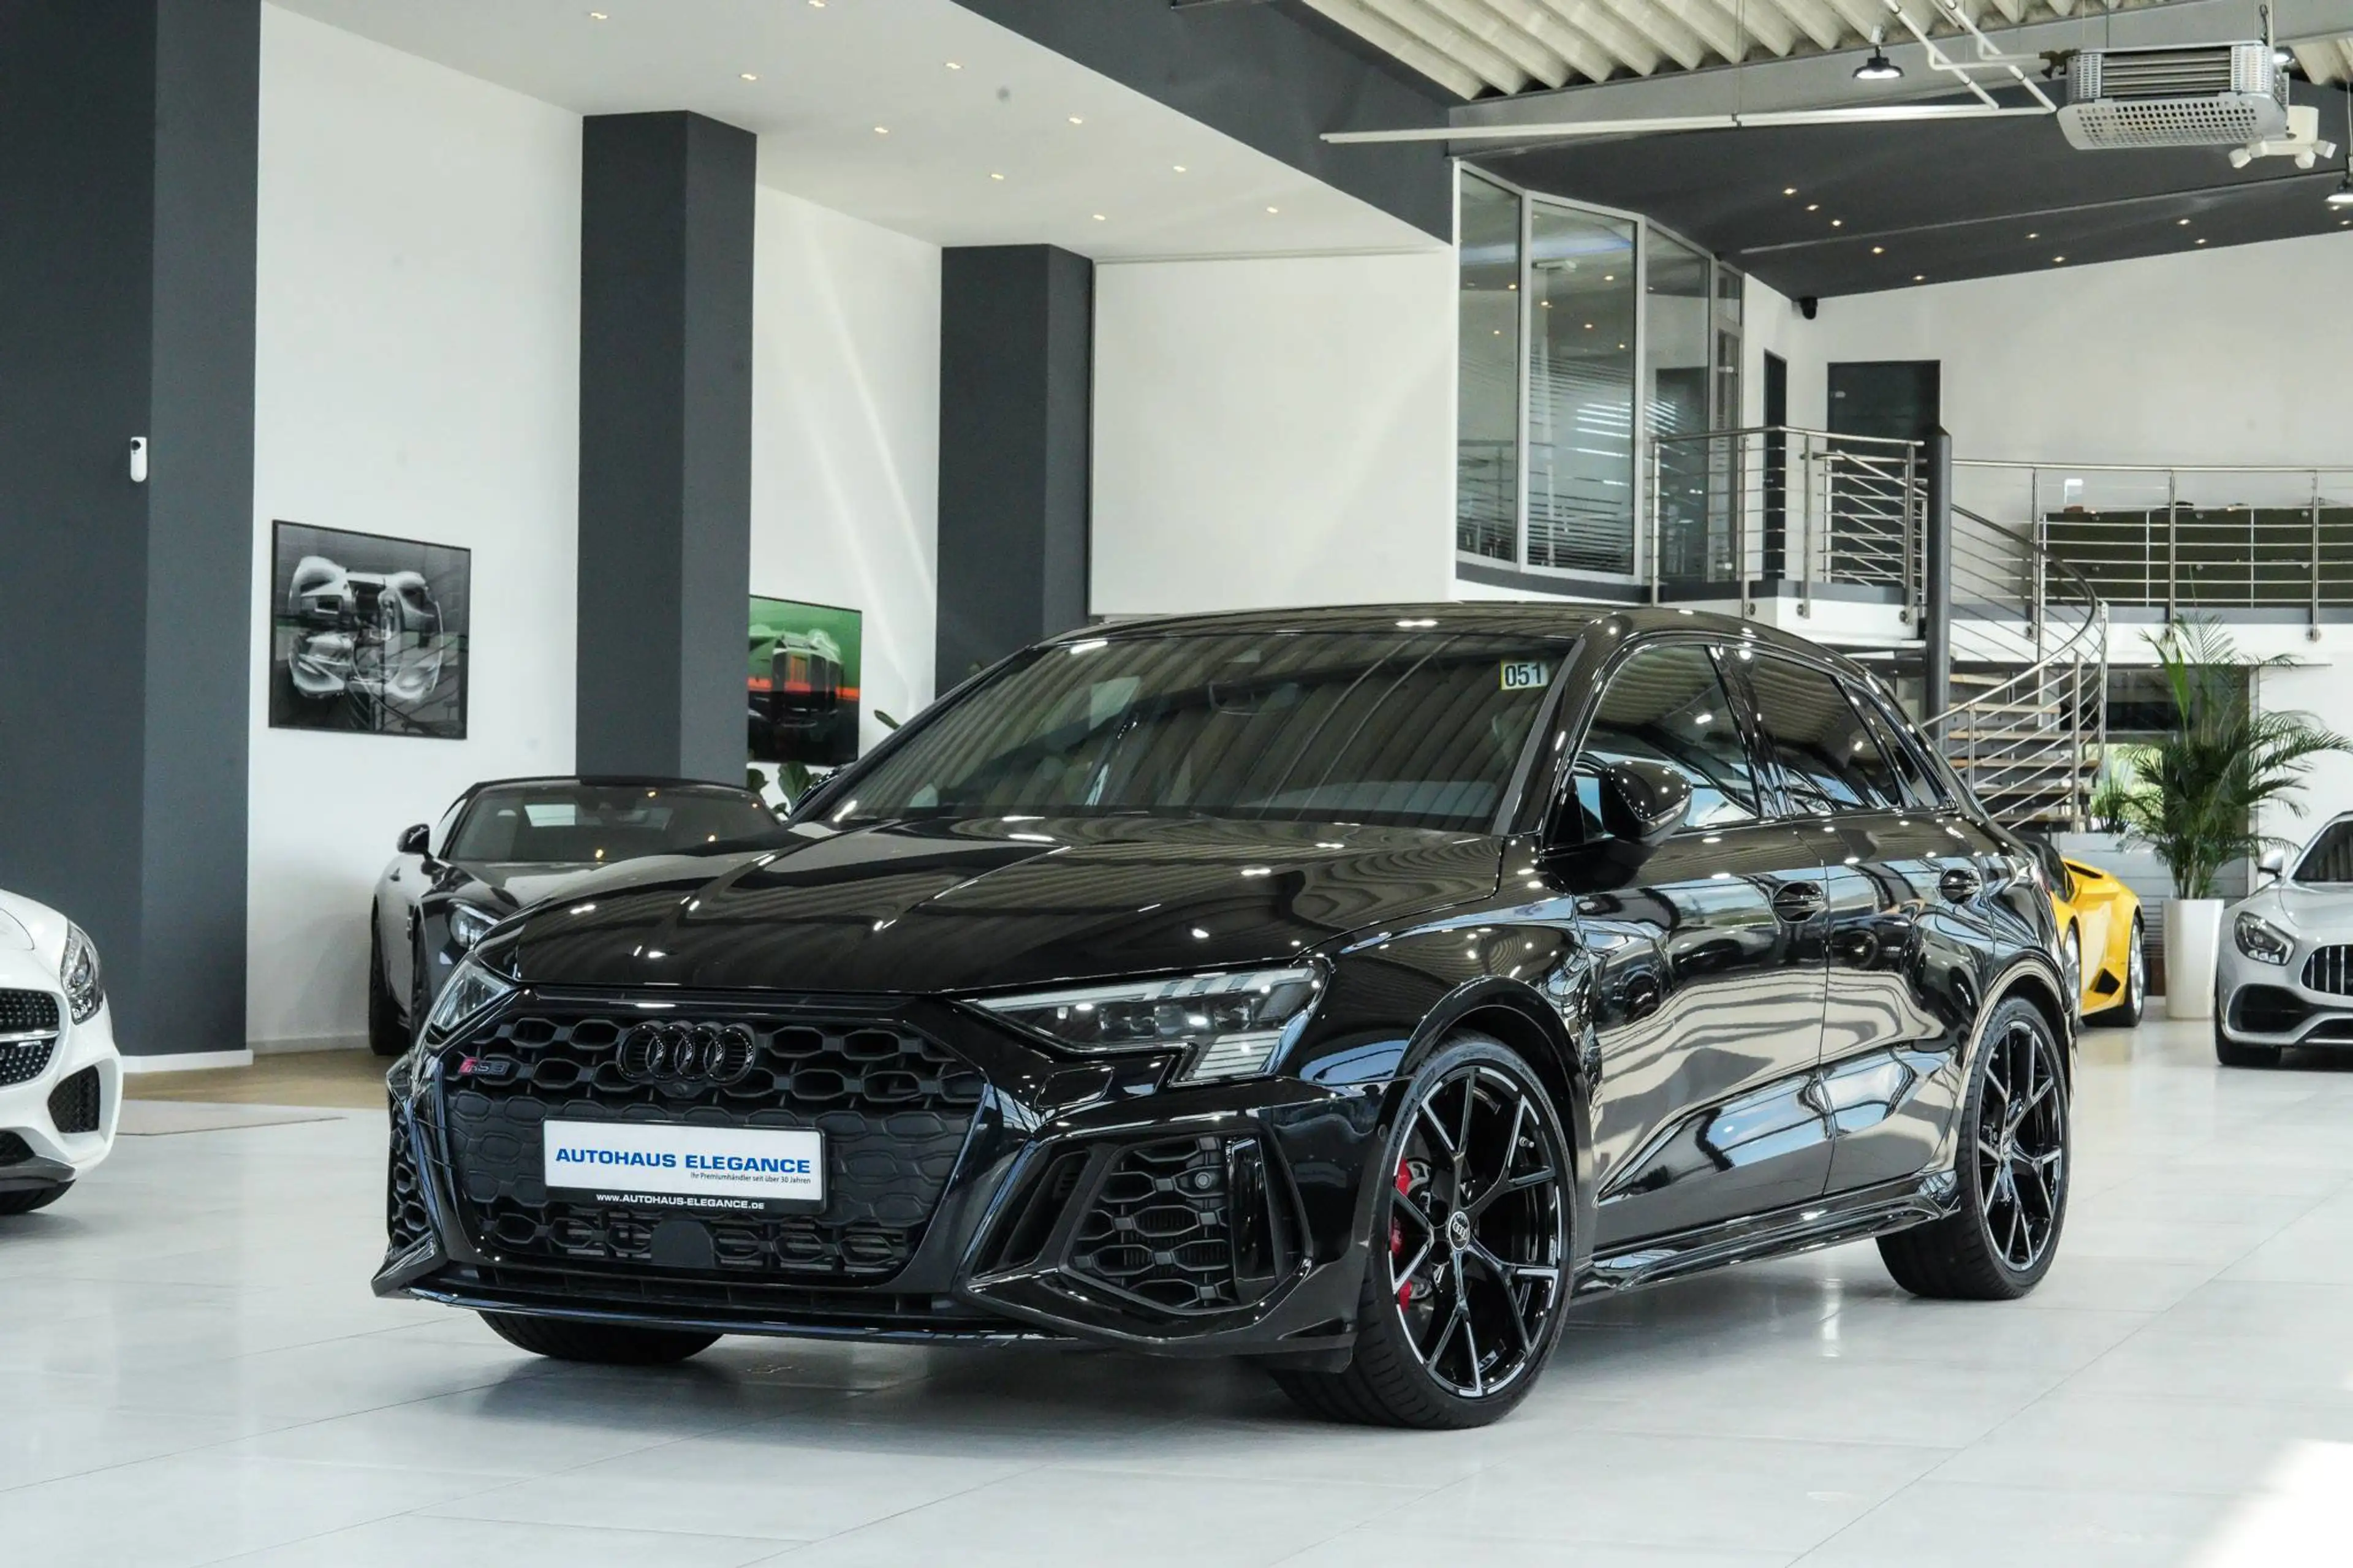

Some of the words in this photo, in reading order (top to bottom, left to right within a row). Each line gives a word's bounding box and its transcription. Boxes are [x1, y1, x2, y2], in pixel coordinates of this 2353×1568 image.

[1505, 662, 1542, 687] 051
[556, 1148, 676, 1168] AUTOHAUS
[685, 1154, 811, 1173] ELEGANCE
[790, 1176, 811, 1185] Jahren
